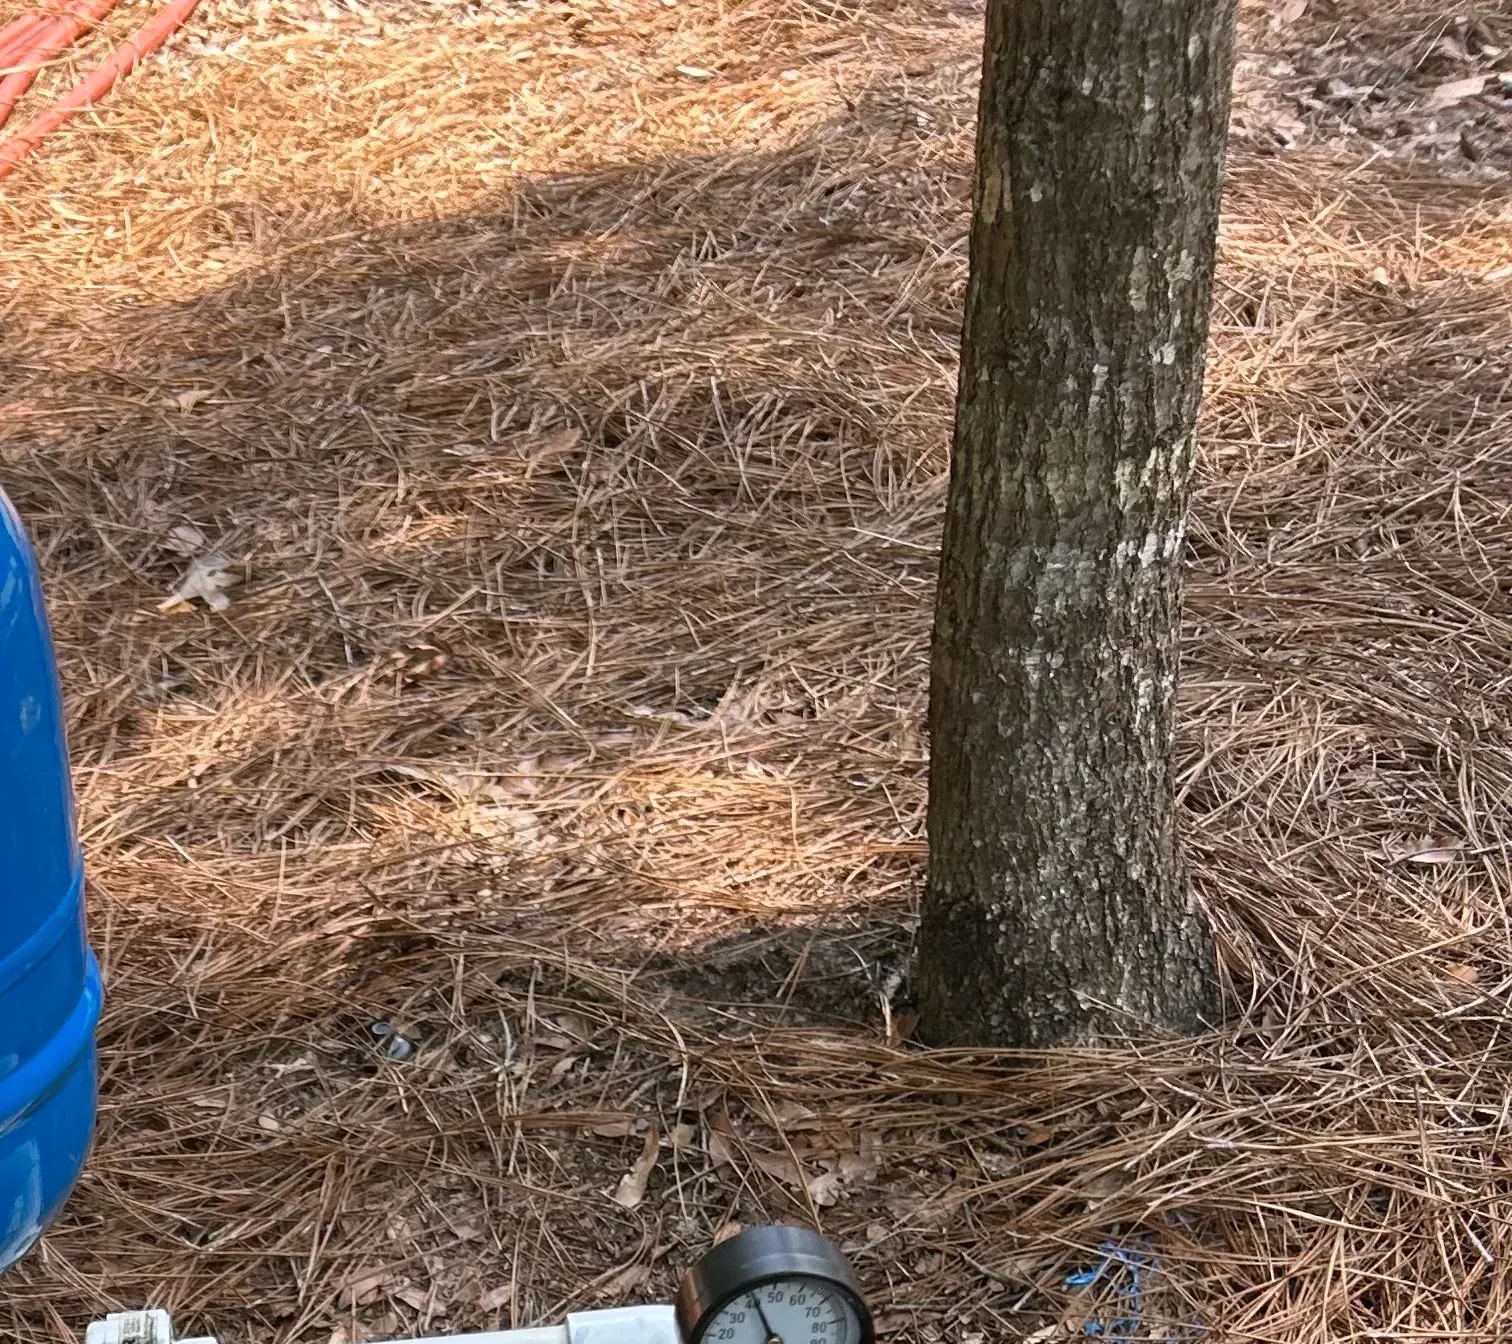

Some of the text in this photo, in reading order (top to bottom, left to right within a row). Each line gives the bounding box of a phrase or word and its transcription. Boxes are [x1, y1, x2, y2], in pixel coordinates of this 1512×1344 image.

[767, 1291, 784, 1303] 50
[789, 1294, 806, 1306] 60
[729, 1312, 746, 1324] 30
[805, 1306, 821, 1318] 70
[811, 1321, 827, 1333] 80
[718, 1327, 734, 1340] 20
